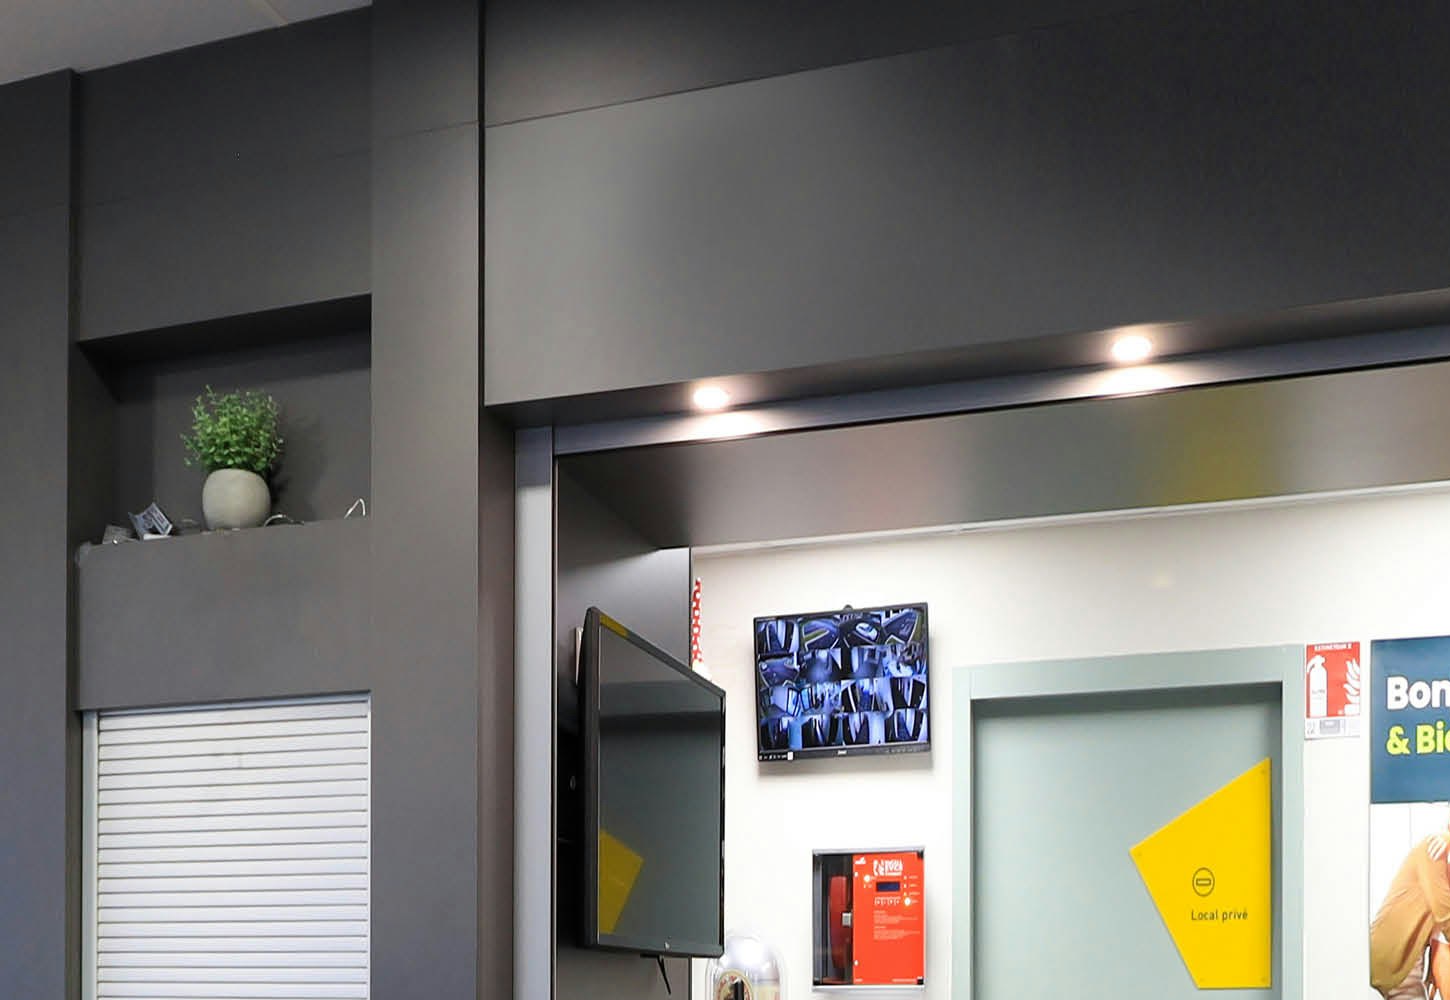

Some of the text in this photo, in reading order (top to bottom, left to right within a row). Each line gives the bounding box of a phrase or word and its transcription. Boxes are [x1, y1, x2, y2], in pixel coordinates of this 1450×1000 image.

[1386, 725, 1411, 755] &
[1191, 906, 1249, 924] Local privé
